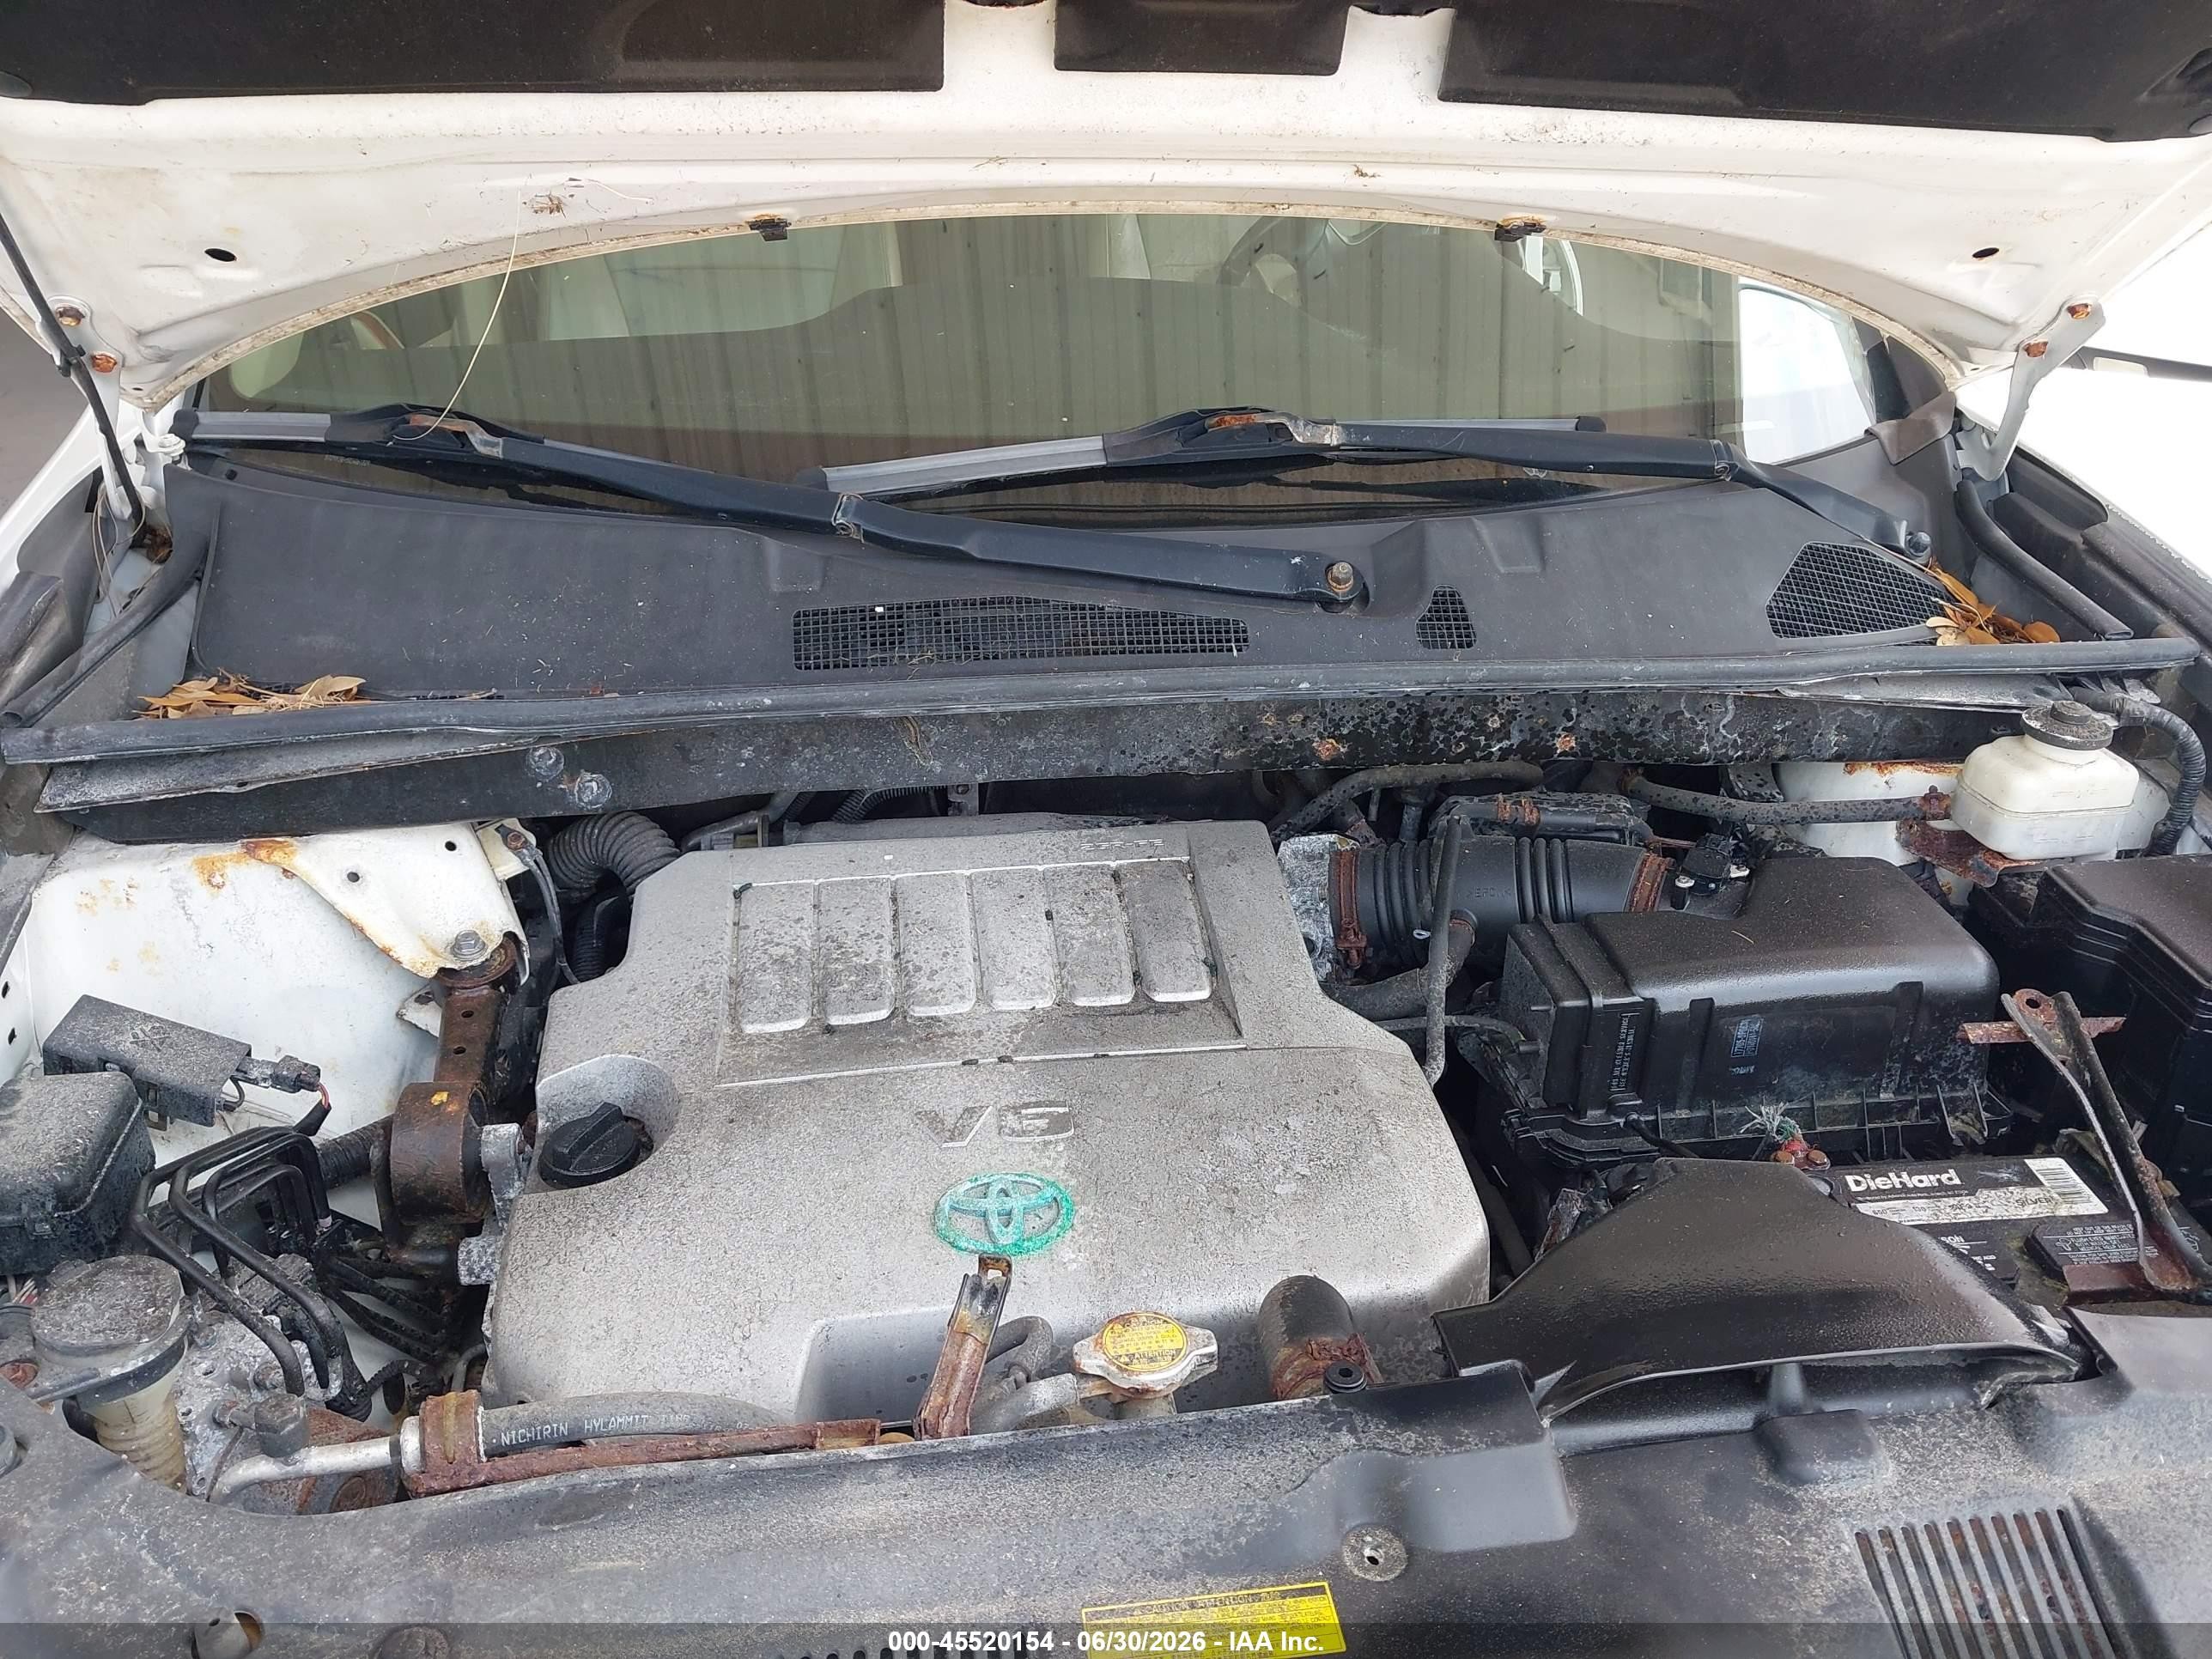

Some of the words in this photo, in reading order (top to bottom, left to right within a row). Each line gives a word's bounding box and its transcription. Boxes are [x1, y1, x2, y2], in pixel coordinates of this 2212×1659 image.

[915, 1099, 1075, 1149] V6
[1844, 1169, 1962, 1192] DieHard
[2015, 1196, 2053, 1207] SILVER
[501, 1422, 568, 1446] NICHIRIN
